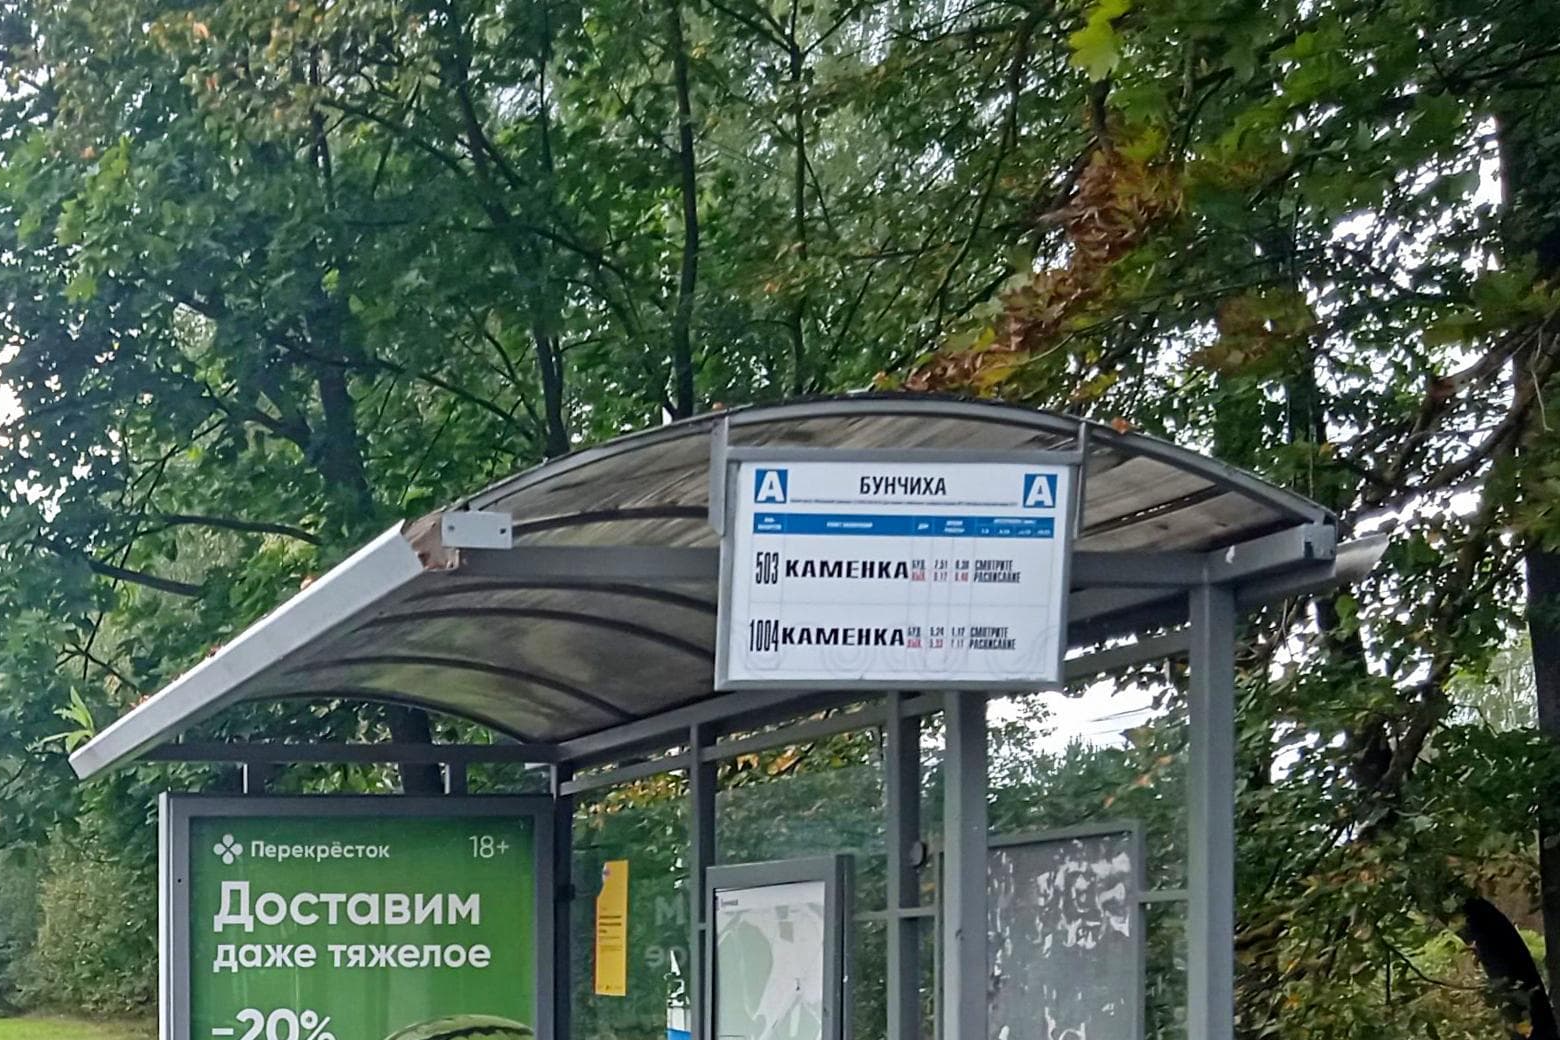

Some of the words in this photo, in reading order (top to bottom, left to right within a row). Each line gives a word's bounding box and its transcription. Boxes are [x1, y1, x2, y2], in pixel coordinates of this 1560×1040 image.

[859, 475, 947, 496] БУНЧИХА
[755, 552, 779, 584] 503
[785, 559, 909, 579] КАМЕНКА
[975, 560, 1013, 571] СМОТРИТЕ
[973, 571, 1020, 583] РАСПИСАНИЕ
[749, 619, 779, 652] 1004
[781, 626, 905, 646] КАМЕНКА
[970, 627, 1008, 638] СМОТРИТЕ
[968, 638, 1016, 651] РАСПИСАНИЕ
[251, 840, 390, 862] Перекрёсток
[468, 835, 510, 858] 18+
[213, 880, 481, 932] Доставим
[213, 944, 317, 973] даже
[328, 944, 491, 968] тяжелое
